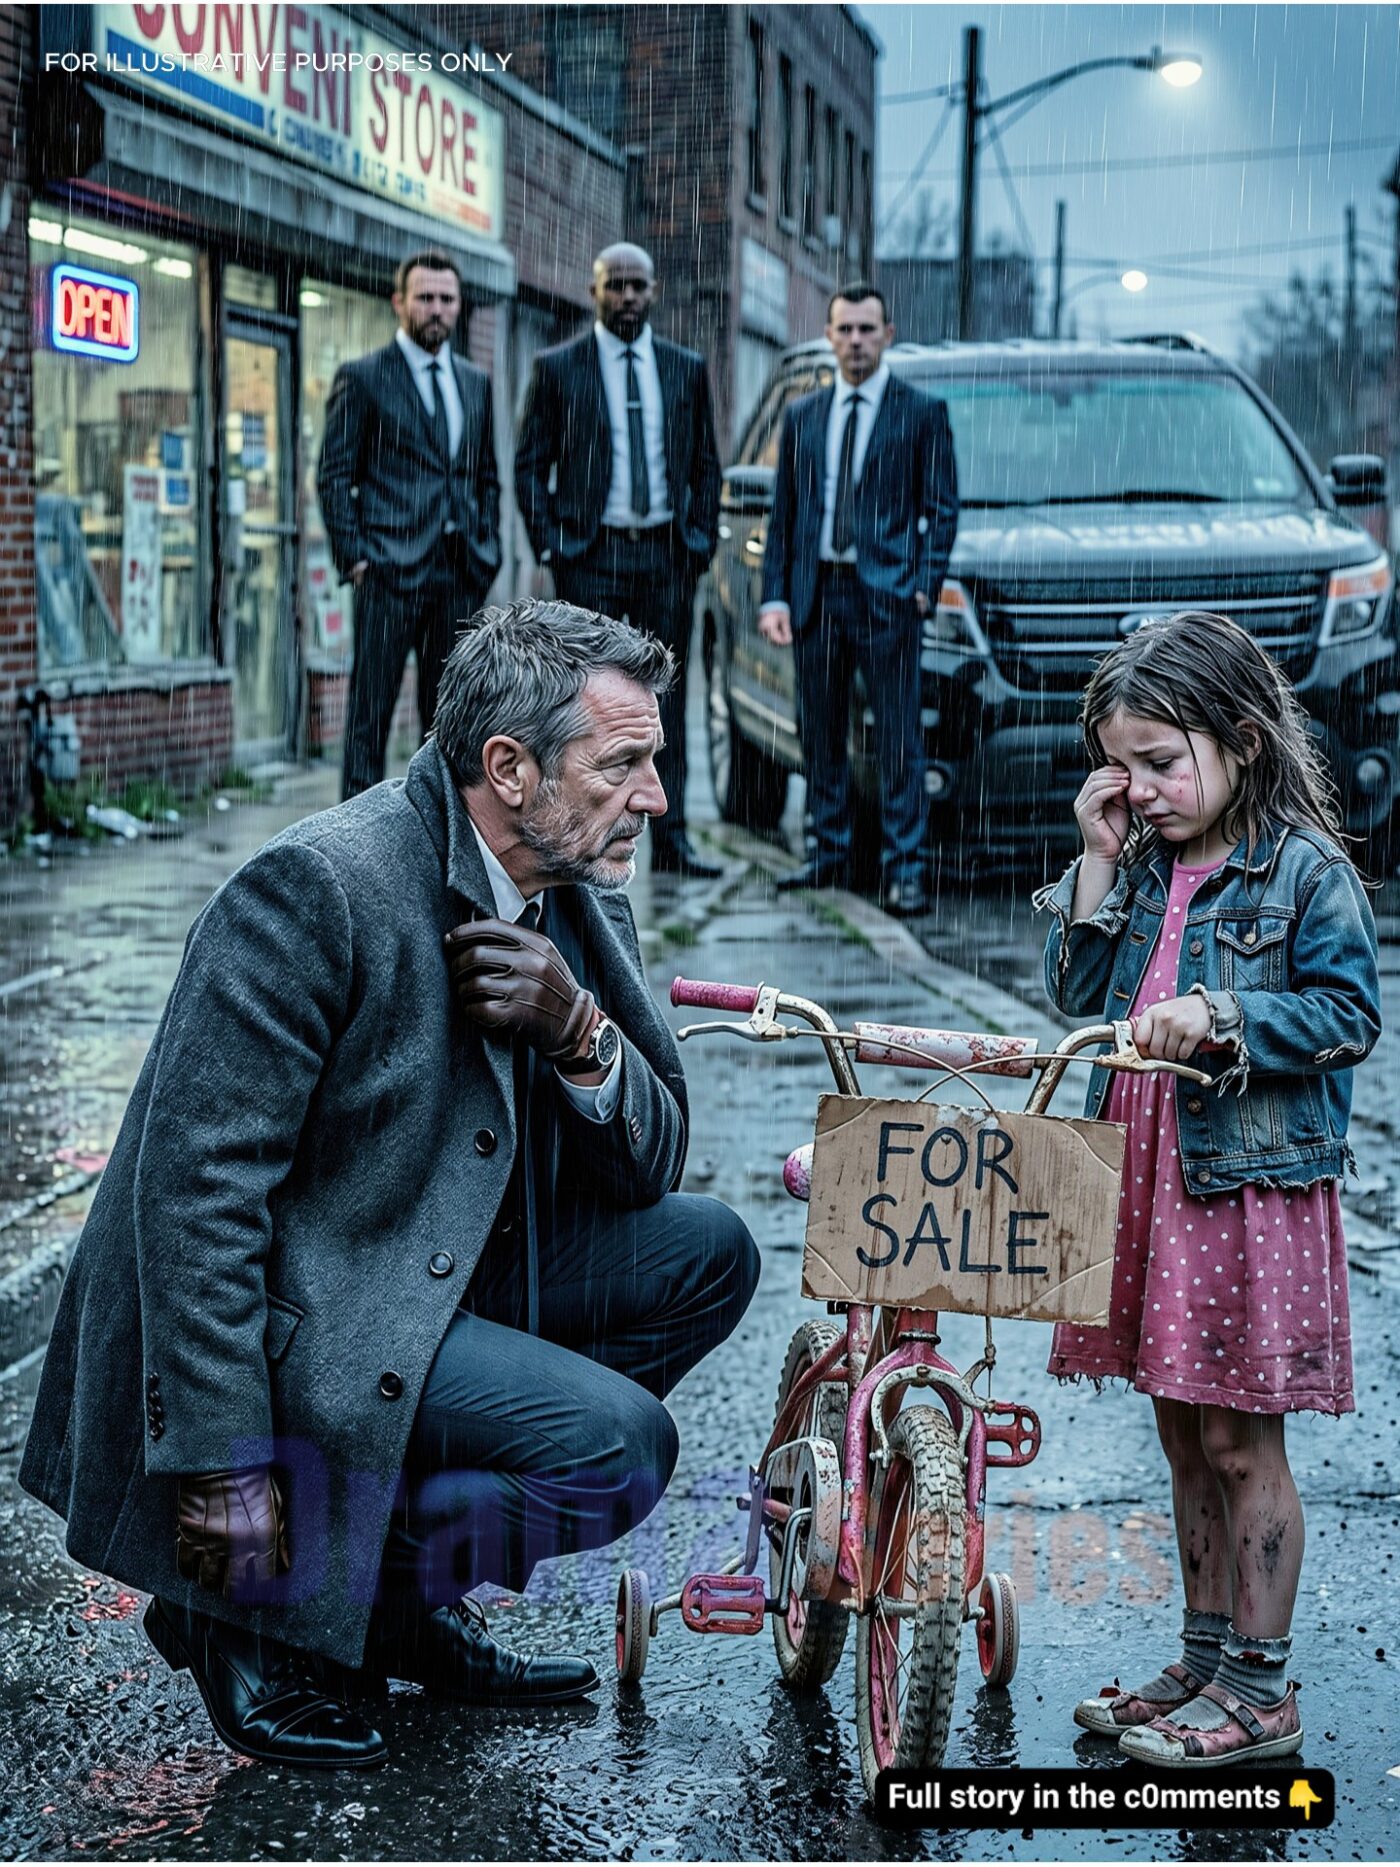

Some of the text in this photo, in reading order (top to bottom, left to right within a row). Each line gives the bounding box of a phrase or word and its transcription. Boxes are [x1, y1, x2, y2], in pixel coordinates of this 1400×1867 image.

[368, 54, 477, 196] STORE
[58, 278, 134, 347] OPEN
[877, 1121, 1019, 1194] FOR
[856, 1193, 1050, 1275] SALE
